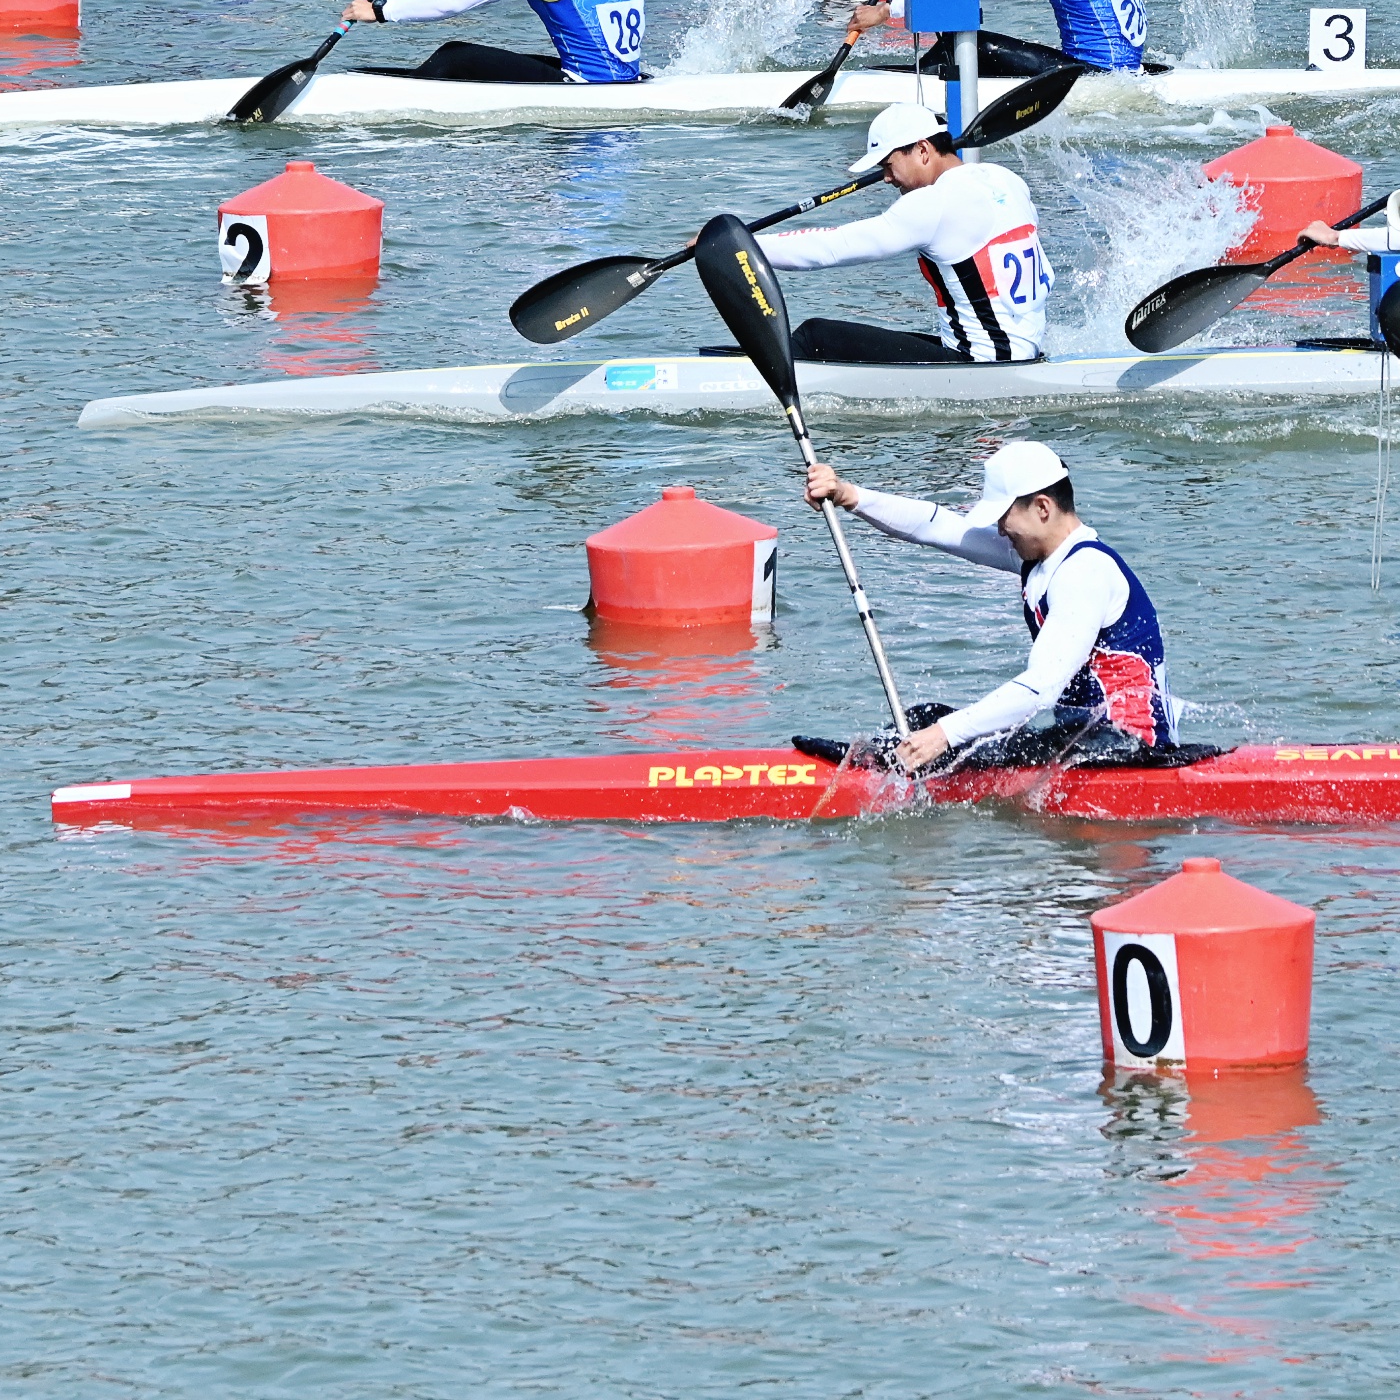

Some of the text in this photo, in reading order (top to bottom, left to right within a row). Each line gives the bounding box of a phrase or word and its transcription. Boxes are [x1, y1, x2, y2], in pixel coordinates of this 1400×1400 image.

[1323, 14, 1356, 62] 3
[224, 222, 264, 285] 2
[1003, 243, 1051, 305] 274
[763, 546, 778, 623] 1
[648, 764, 817, 787] PLASTEX
[1112, 943, 1173, 1058] 0
